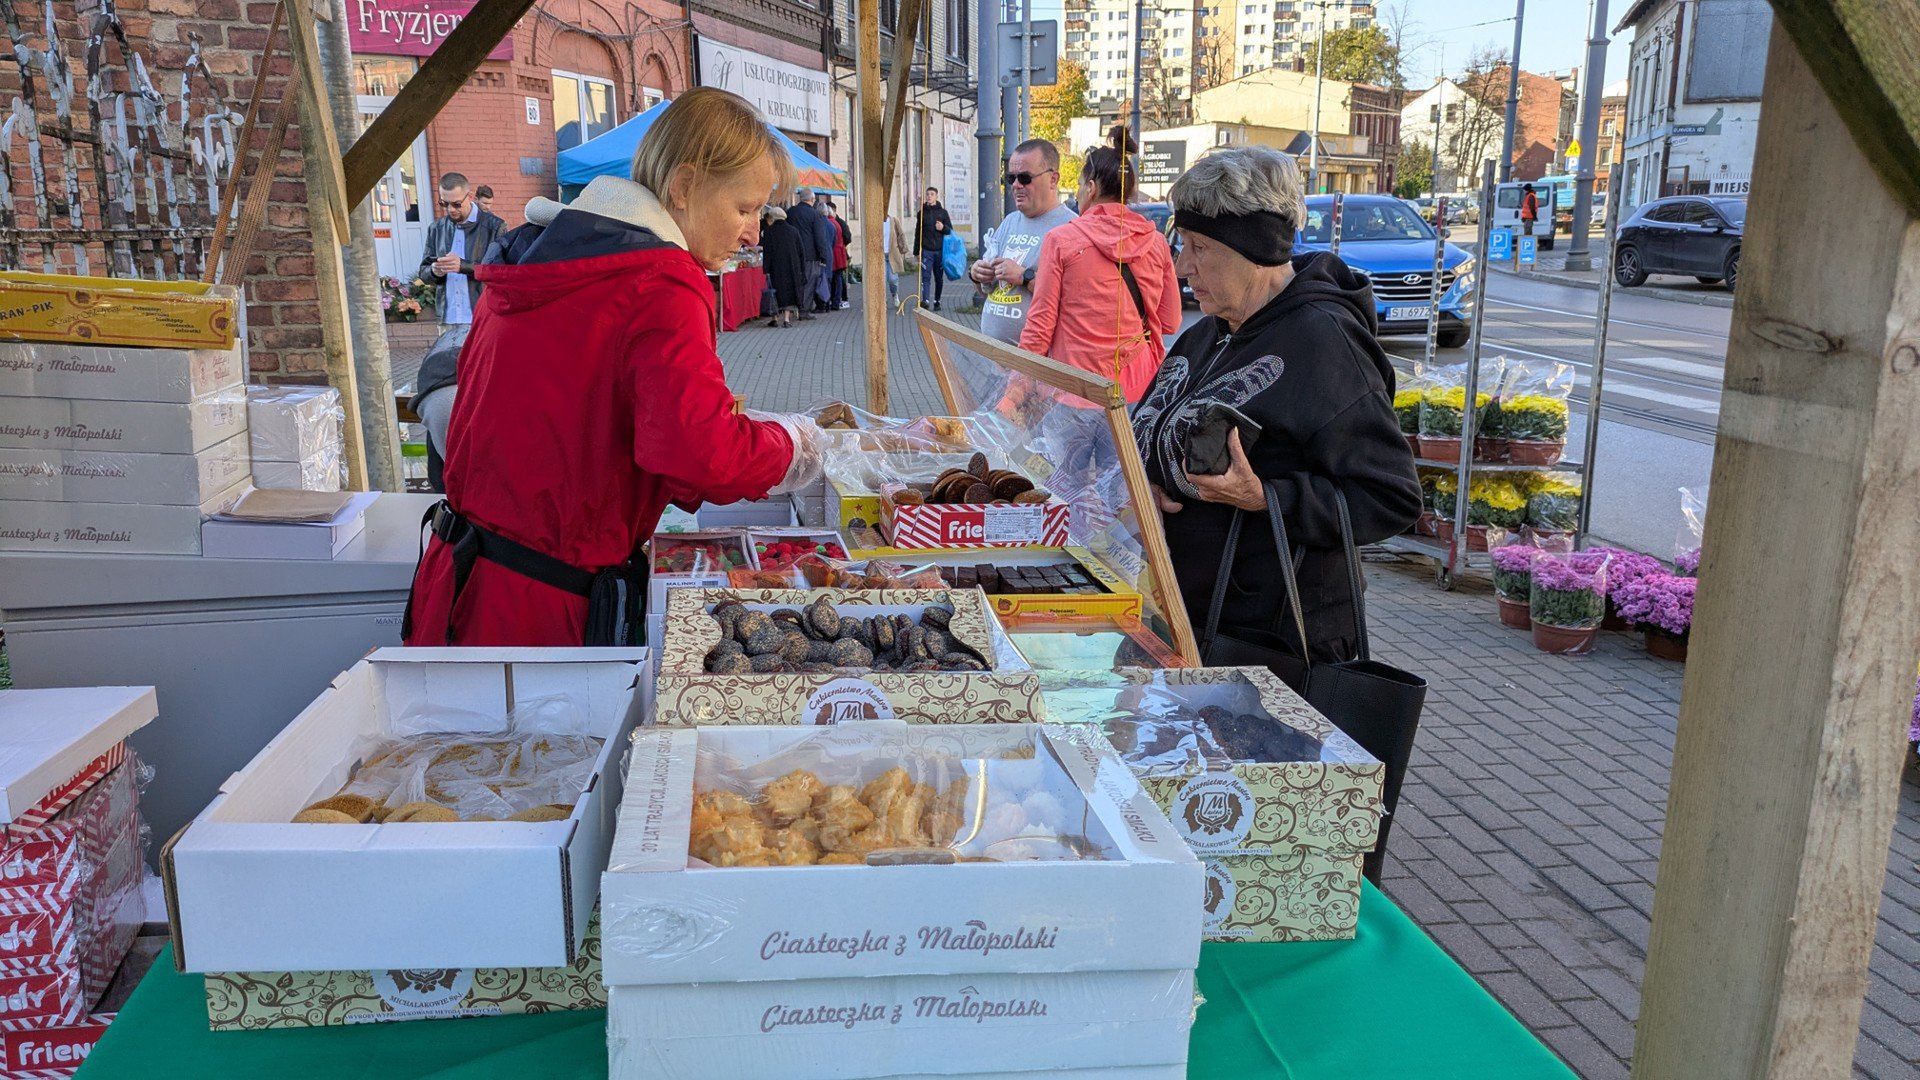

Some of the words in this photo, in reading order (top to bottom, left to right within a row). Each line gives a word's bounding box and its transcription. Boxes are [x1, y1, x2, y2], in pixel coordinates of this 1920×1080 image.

[357, 0, 463, 45] Fryzjer
[744, 61, 775, 84] USŁUGI
[778, 71, 827, 96] POGRZEBOWE
[768, 100, 818, 123] KREMACYJNE
[1714, 182, 1750, 193] MIEJS
[1007, 234, 1028, 245] THIS
[1027, 235, 1040, 246] IS
[1493, 235, 1503, 246] P
[1524, 242, 1531, 250] P
[1392, 308, 1404, 317] SI
[48, 355, 116, 374] Małopolski
[54, 424, 122, 441] Małopolski
[60, 461, 127, 479] Małopolski
[64, 527, 132, 543] Małopolski
[643, 826, 660, 841] LAT
[657, 730, 673, 753] SMAKU
[1124, 813, 1158, 843] SMAKU
[760, 929, 888, 960] Ciasteczka
[894, 934, 907, 956] z
[917, 920, 1059, 956] Małopolski
[760, 1003, 886, 1033] Ciasteczka
[891, 1004, 903, 1024] z
[913, 986, 1048, 1024] Małopolski
